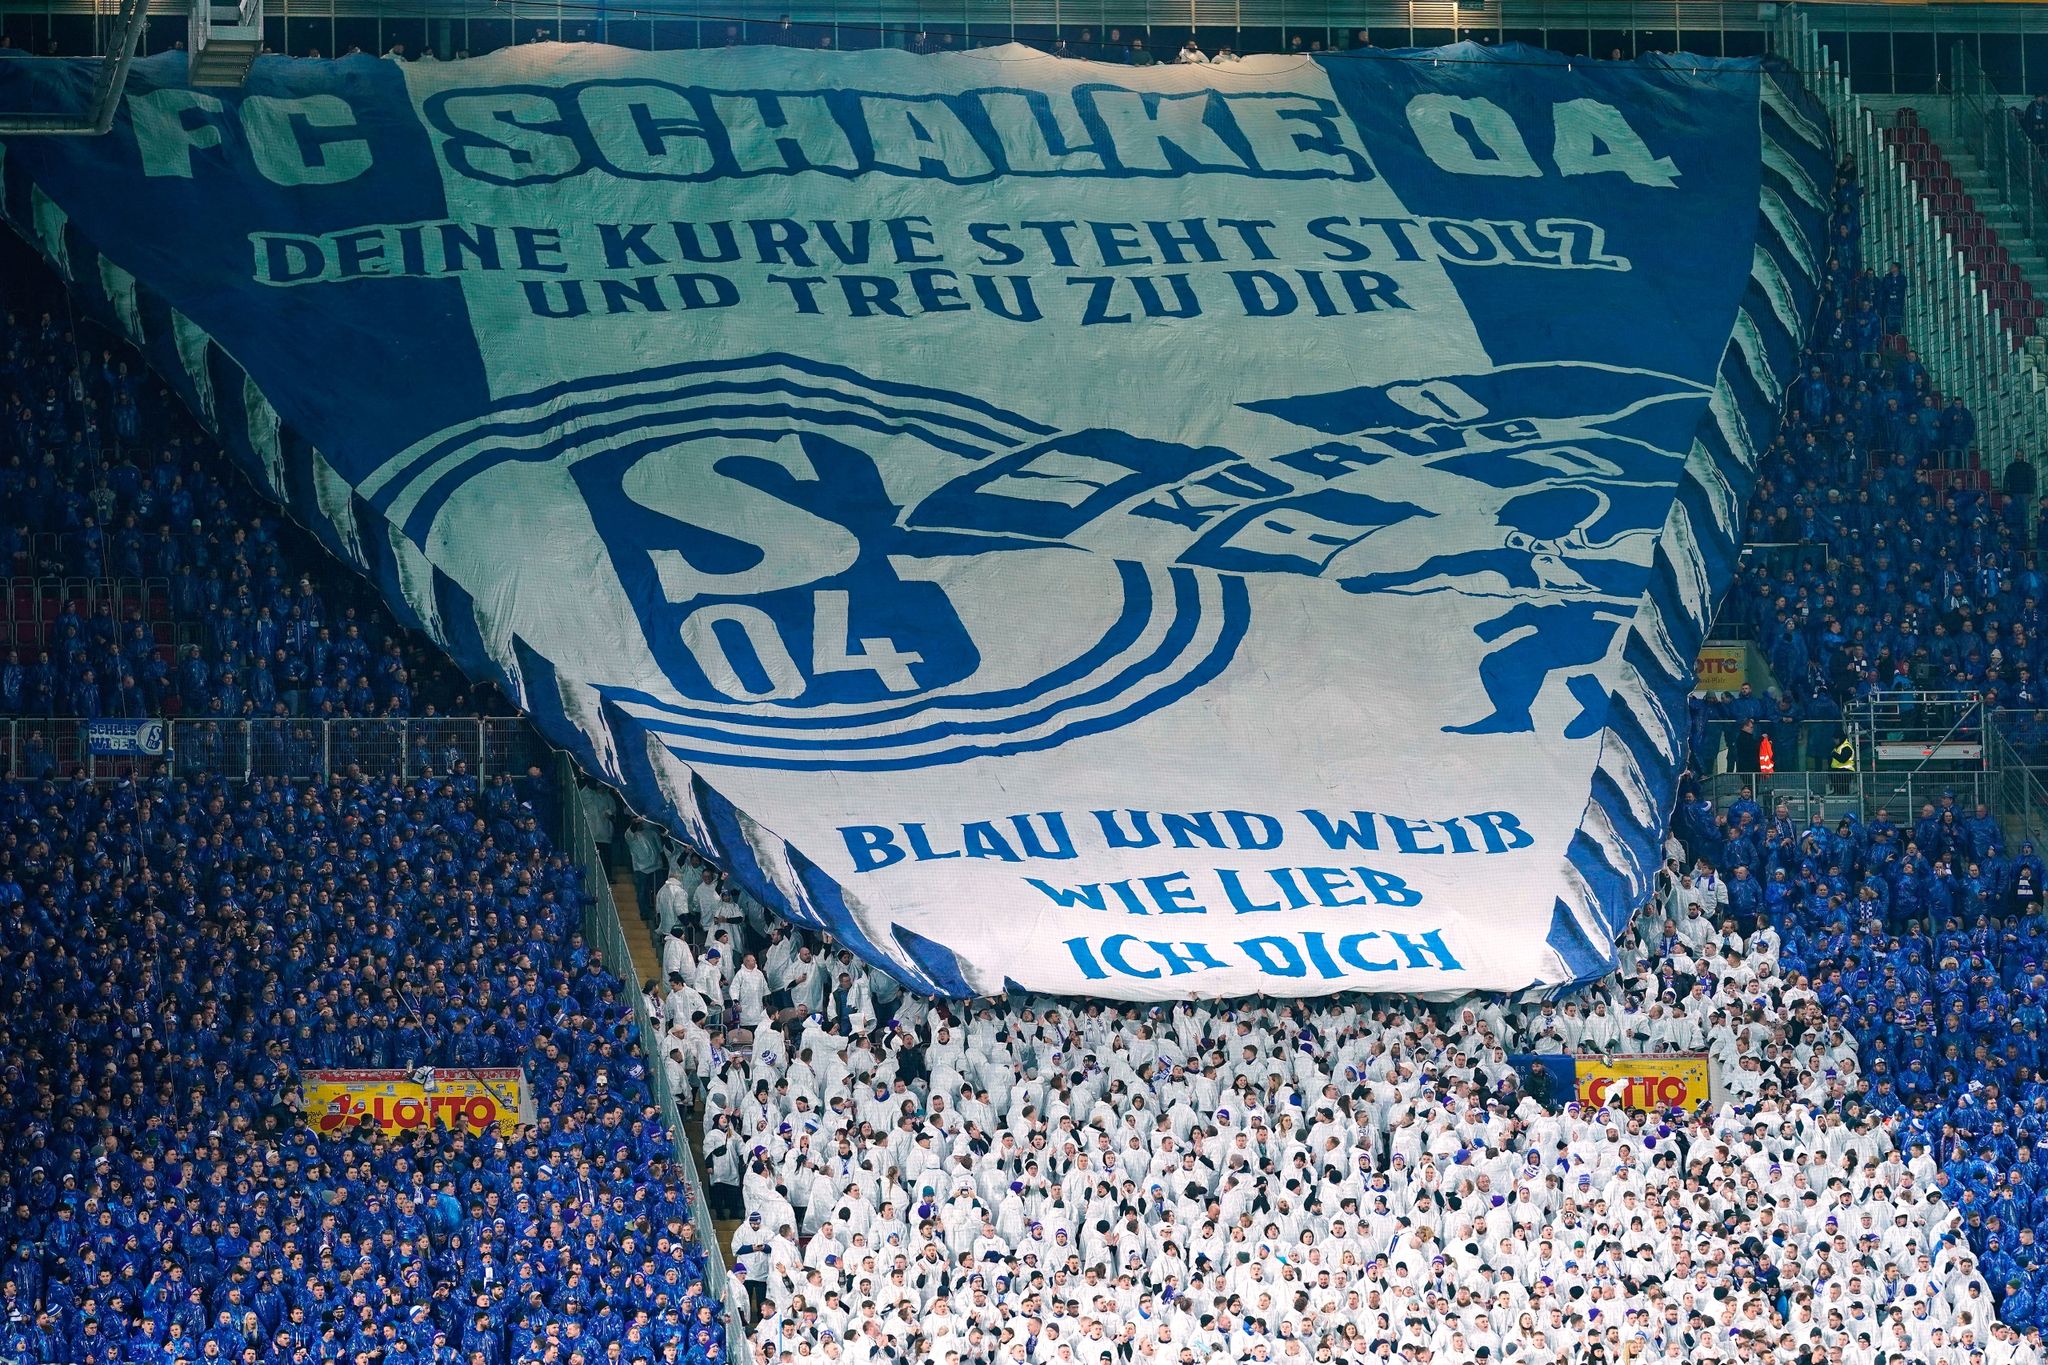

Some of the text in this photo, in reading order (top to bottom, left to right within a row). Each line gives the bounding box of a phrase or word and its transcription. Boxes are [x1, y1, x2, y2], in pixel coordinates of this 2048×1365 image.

[124, 81, 1682, 189] FC SCHALKE 04
[262, 215, 1616, 282] DEINE KURVE STEHT STOLZ
[517, 267, 1414, 326] UND TREU ZU DIR
[680, 590, 924, 701] 04
[90, 724, 137, 735] SCHLES
[90, 738, 137, 750] WIGER
[836, 811, 1078, 872] BLAU
[1091, 809, 1283, 850] UND
[1023, 867, 1424, 915] WIE LIEB
[1062, 929, 1467, 980] ICH DICH
[374, 1096, 496, 1128] LOTTO
[1576, 1077, 1687, 1107] LOTTO
